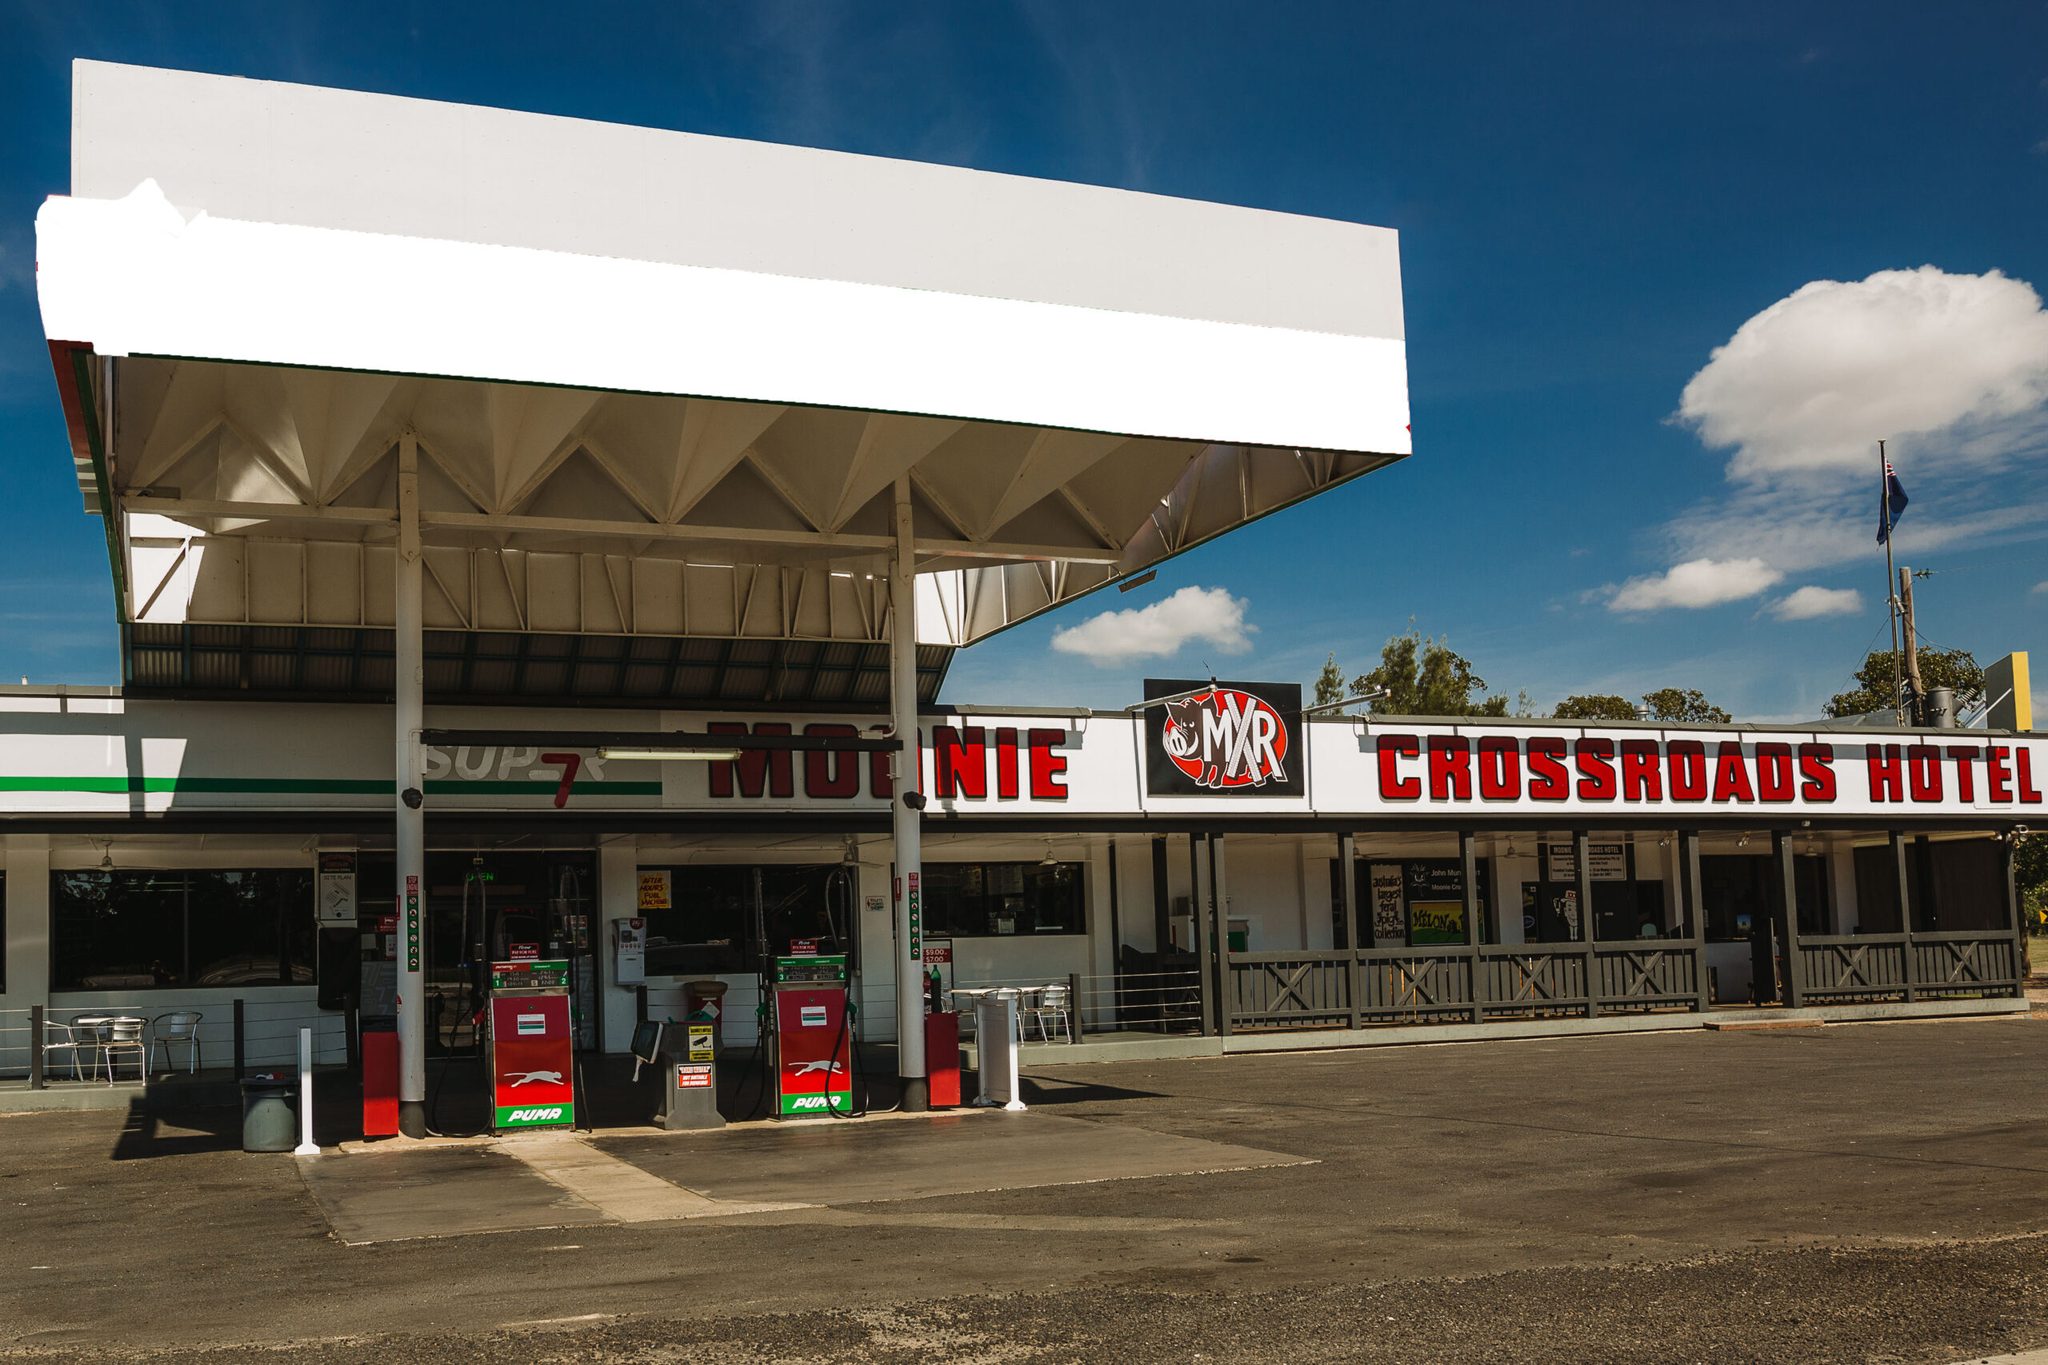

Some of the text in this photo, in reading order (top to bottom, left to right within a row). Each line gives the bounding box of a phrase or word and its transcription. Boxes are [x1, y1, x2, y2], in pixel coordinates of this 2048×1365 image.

[1202, 692, 1284, 784] MXR
[424, 745, 608, 781] SUP
[1376, 733, 2043, 804] CROSSROADS HOTEL
[466, 872, 494, 881] OEN
[507, 1107, 563, 1122] PUMA
[791, 1095, 842, 1109] PUMA
